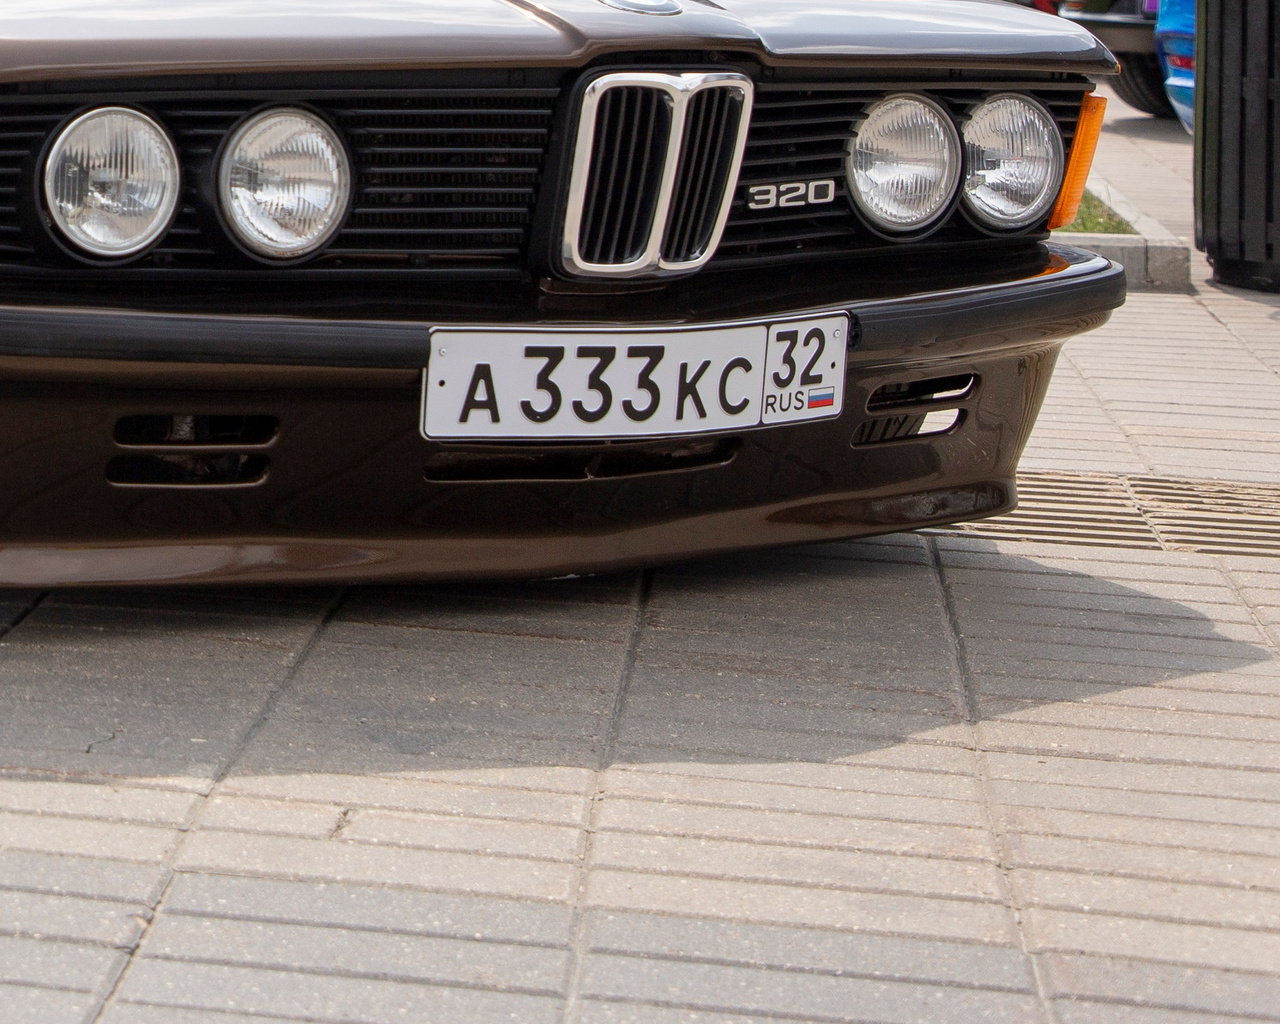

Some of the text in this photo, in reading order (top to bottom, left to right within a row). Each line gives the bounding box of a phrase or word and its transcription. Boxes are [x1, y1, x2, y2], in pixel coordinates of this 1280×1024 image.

[748, 180, 835, 209] 320
[772, 327, 826, 389] 32
[764, 389, 806, 416] RUS
